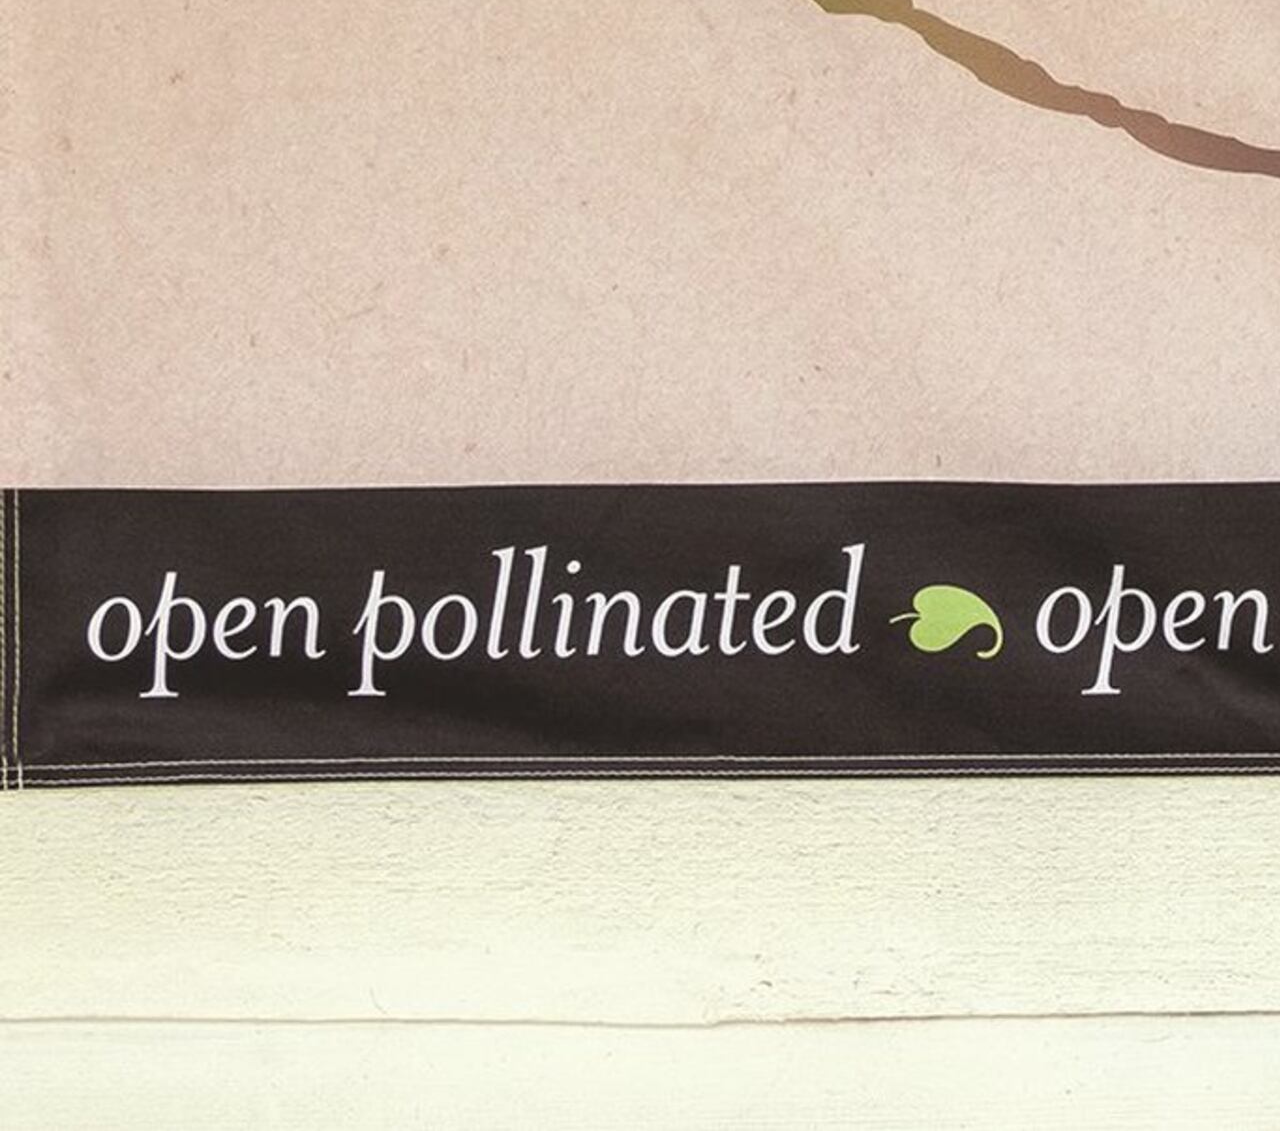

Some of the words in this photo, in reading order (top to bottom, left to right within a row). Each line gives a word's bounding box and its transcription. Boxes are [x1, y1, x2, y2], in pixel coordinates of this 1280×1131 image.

[86, 571, 326, 699] open
[347, 543, 866, 698] pollinated
[1036, 564, 1274, 696] open
